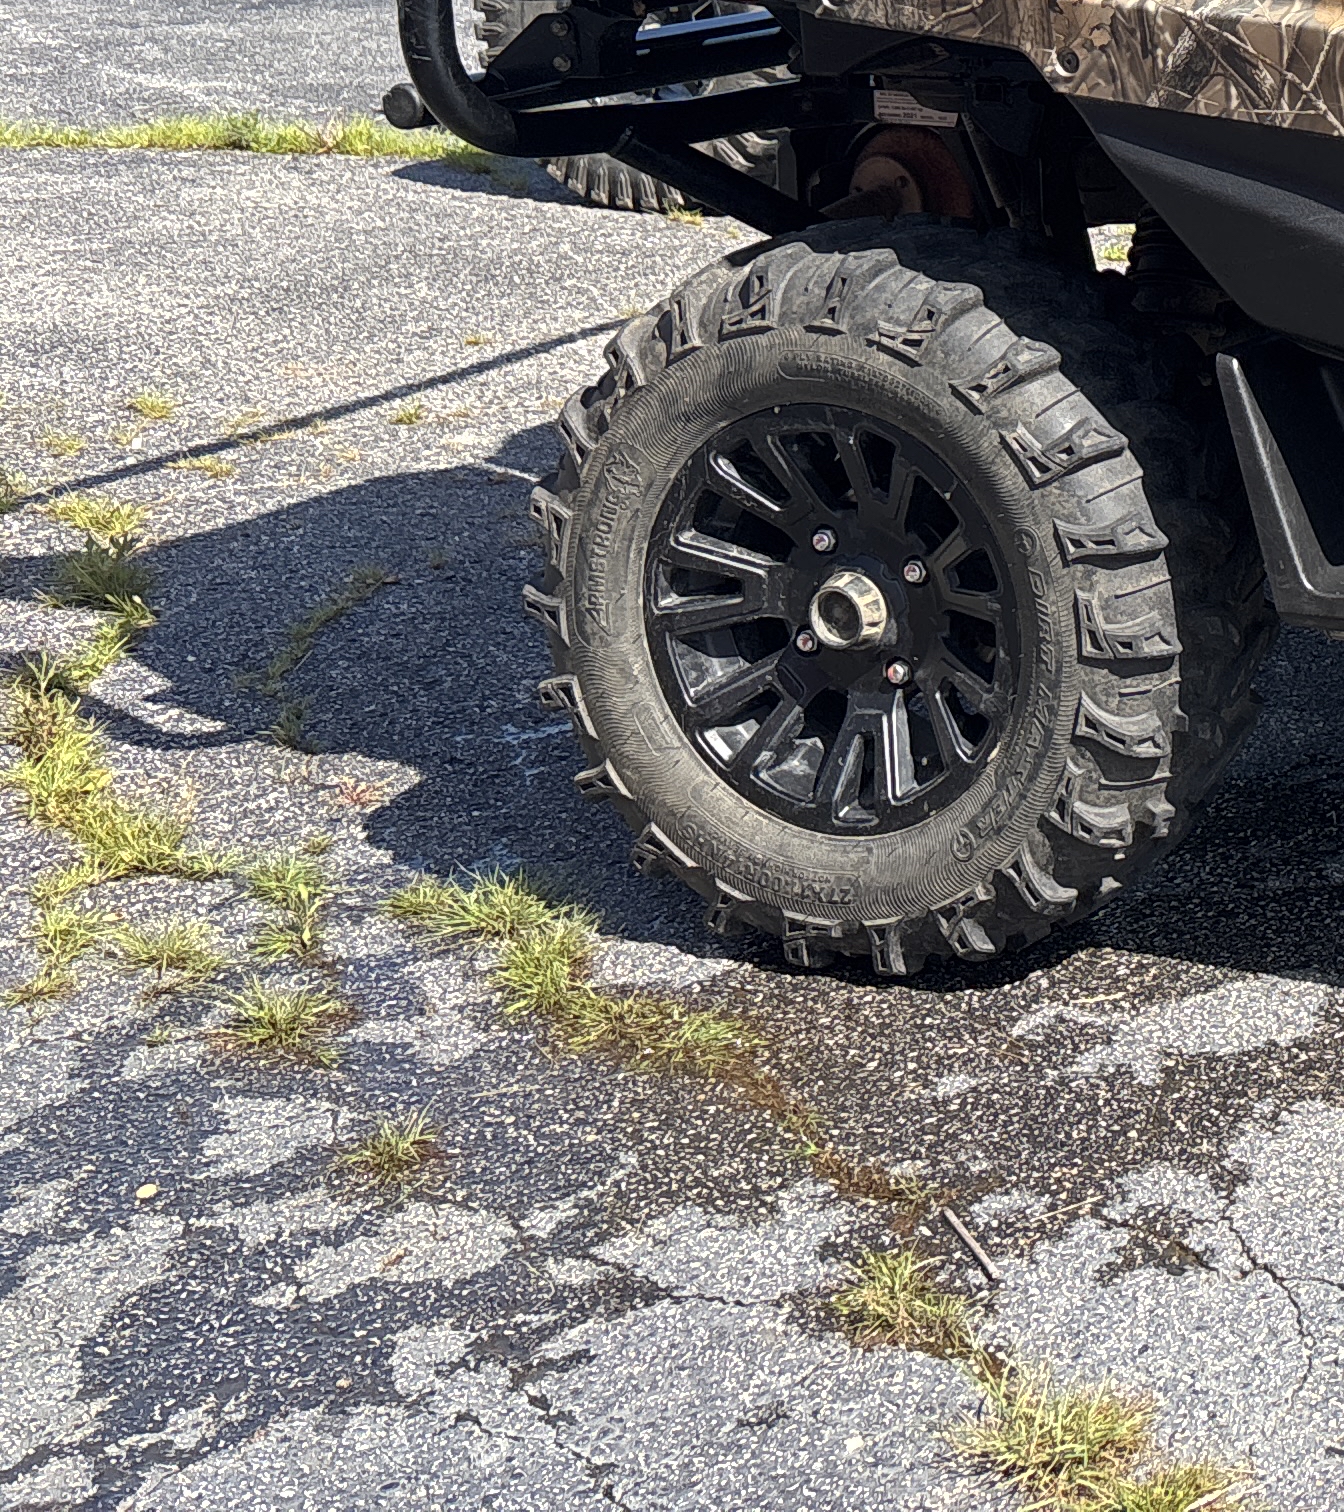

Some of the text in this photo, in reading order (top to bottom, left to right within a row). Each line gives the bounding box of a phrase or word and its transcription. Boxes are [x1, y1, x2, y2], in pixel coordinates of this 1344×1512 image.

[585, 493, 630, 637] ARMSTRONG
[1026, 568, 1056, 675] DIRT
[977, 682, 1054, 838] MASTER
